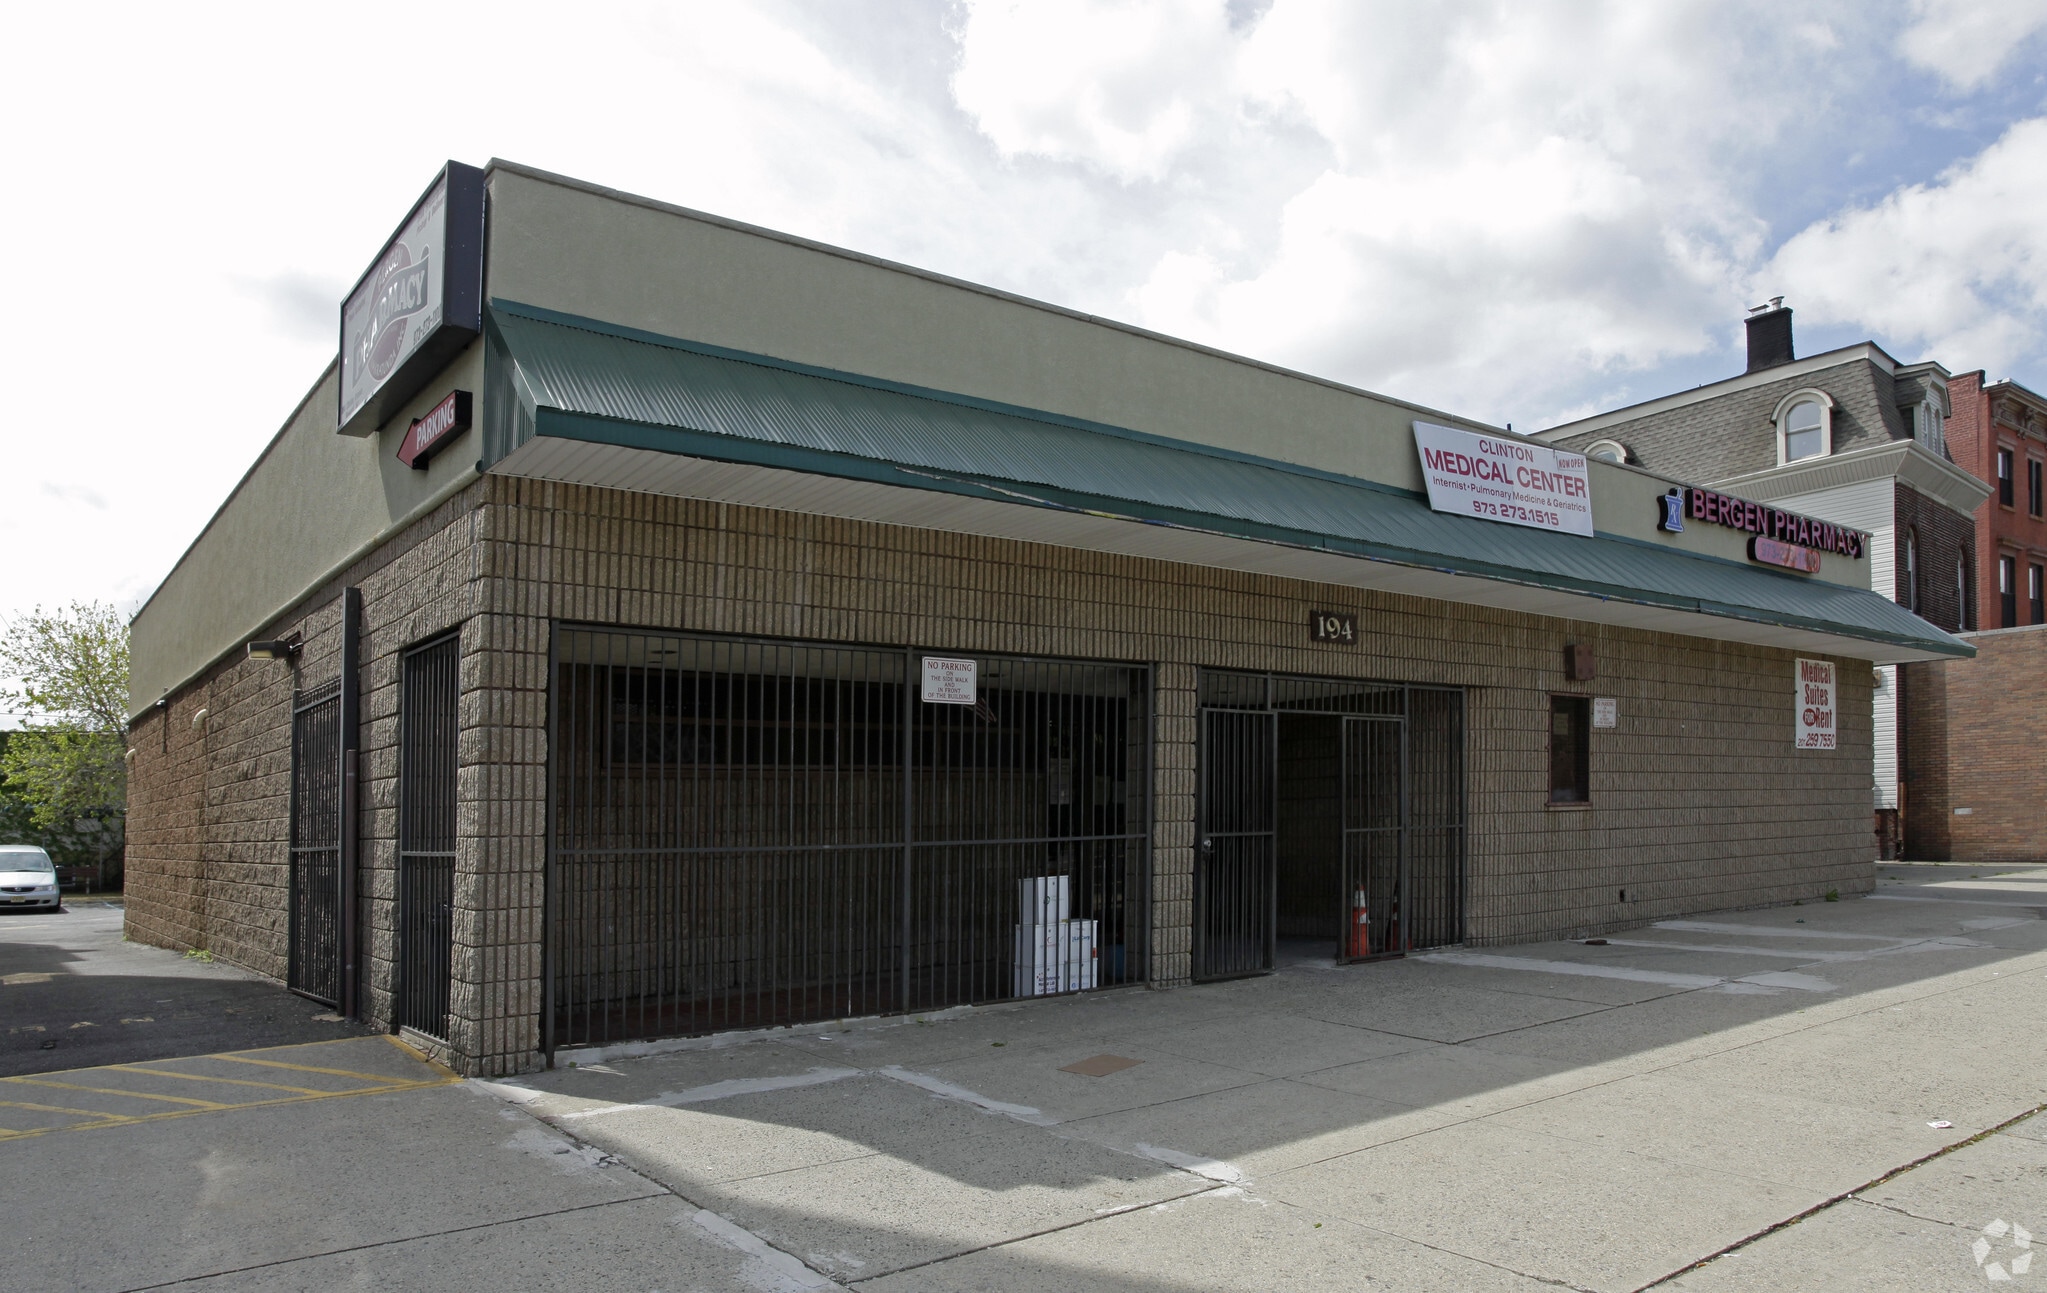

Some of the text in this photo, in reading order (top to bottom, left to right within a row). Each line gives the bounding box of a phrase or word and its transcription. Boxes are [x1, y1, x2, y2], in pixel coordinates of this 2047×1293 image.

[416, 399, 455, 450] PARKING
[1479, 439, 1534, 463] CLINTON
[1424, 447, 1587, 498] MEDICAL CENTER
[1571, 459, 1584, 468] OPEN
[1433, 476, 1587, 513] Internist Pulmonary Medicine & Geriatrics
[1473, 500, 1559, 526] 973 273.1515
[1692, 488, 1868, 559] BERGEN PHARMACY
[1318, 616, 1352, 640] 194
[927, 661, 972, 672] NO PARKING
[1801, 661, 1831, 684] Medical
[1805, 683, 1828, 706] Suites
[1815, 707, 1833, 728] Rent
